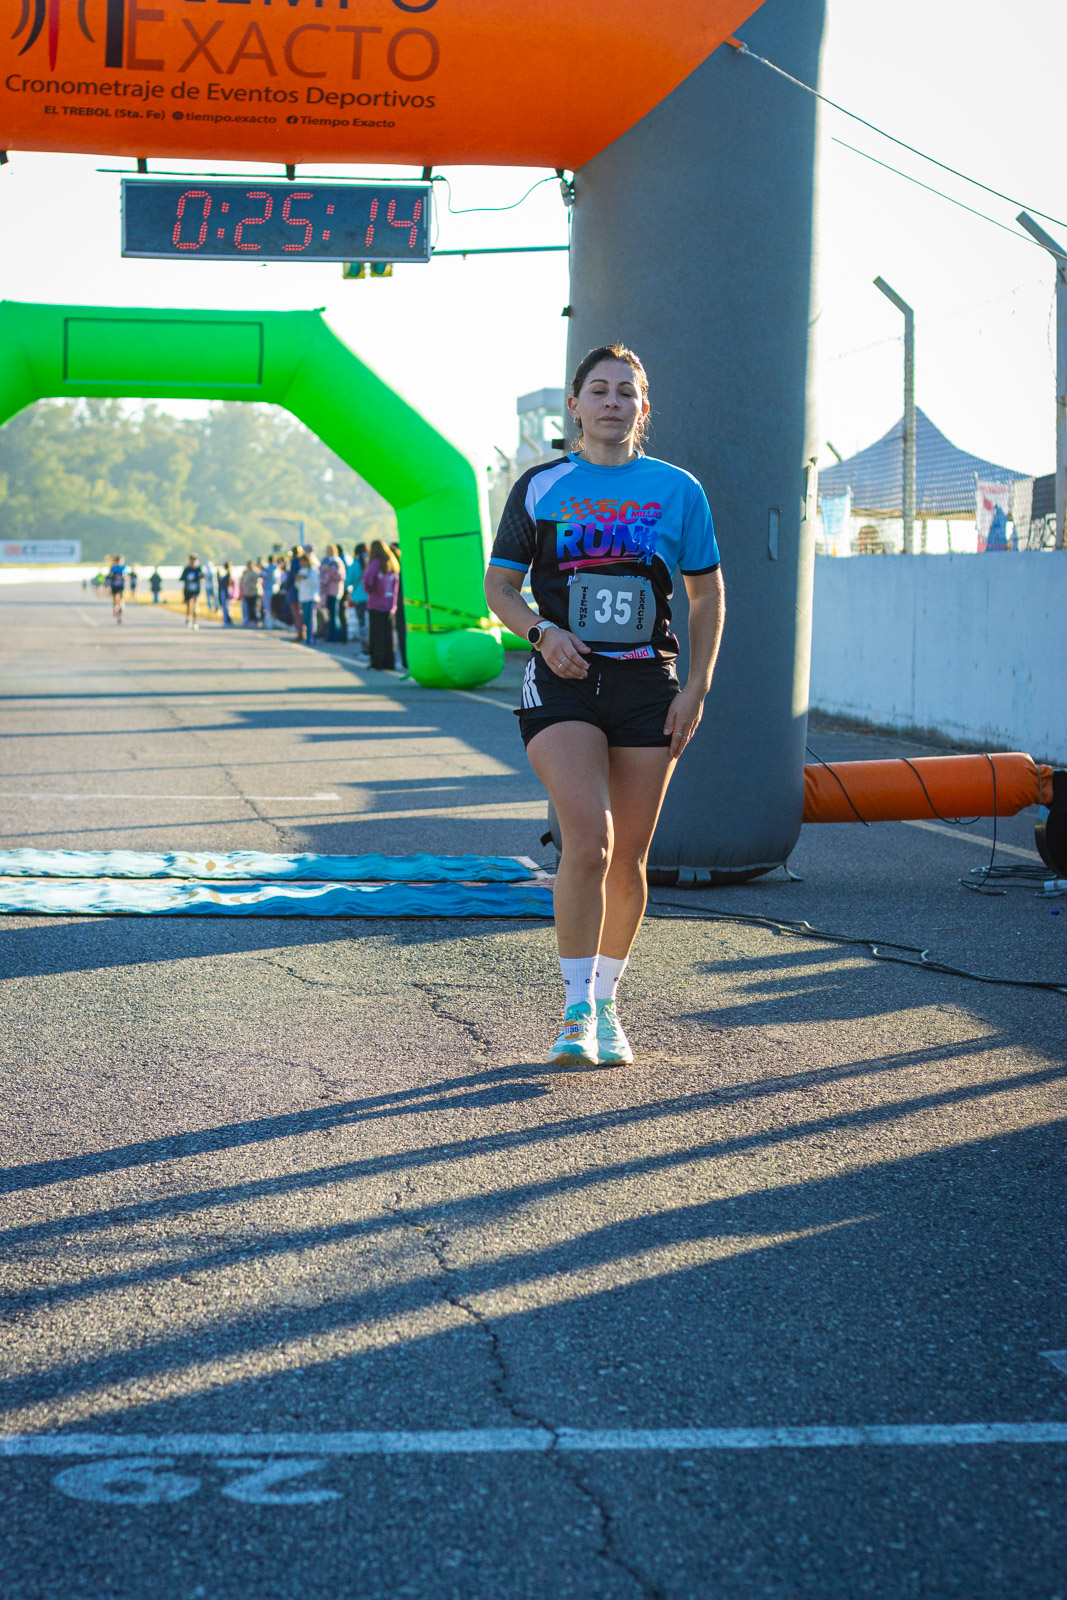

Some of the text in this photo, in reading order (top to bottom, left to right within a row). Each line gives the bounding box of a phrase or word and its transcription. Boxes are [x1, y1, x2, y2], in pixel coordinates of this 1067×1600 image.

[127, 0, 440, 82] EXACTO
[5, 74, 436, 109] Cronometraje de Eventos Deportivos
[44, 105, 165, 120] EL TREBOL (Sta. Fe)
[185, 112, 277, 124] tiempo.exacto
[300, 115, 396, 128] Tiempo Exacto
[172, 190, 422, 251] 0:25:14
[631, 509, 662, 520] MILLAS
[556, 522, 644, 558] RUN
[578, 586, 589, 627] TIEMPO
[594, 588, 633, 625] 35
[636, 590, 646, 630] EXACTO
[622, 646, 650, 660] Salud
